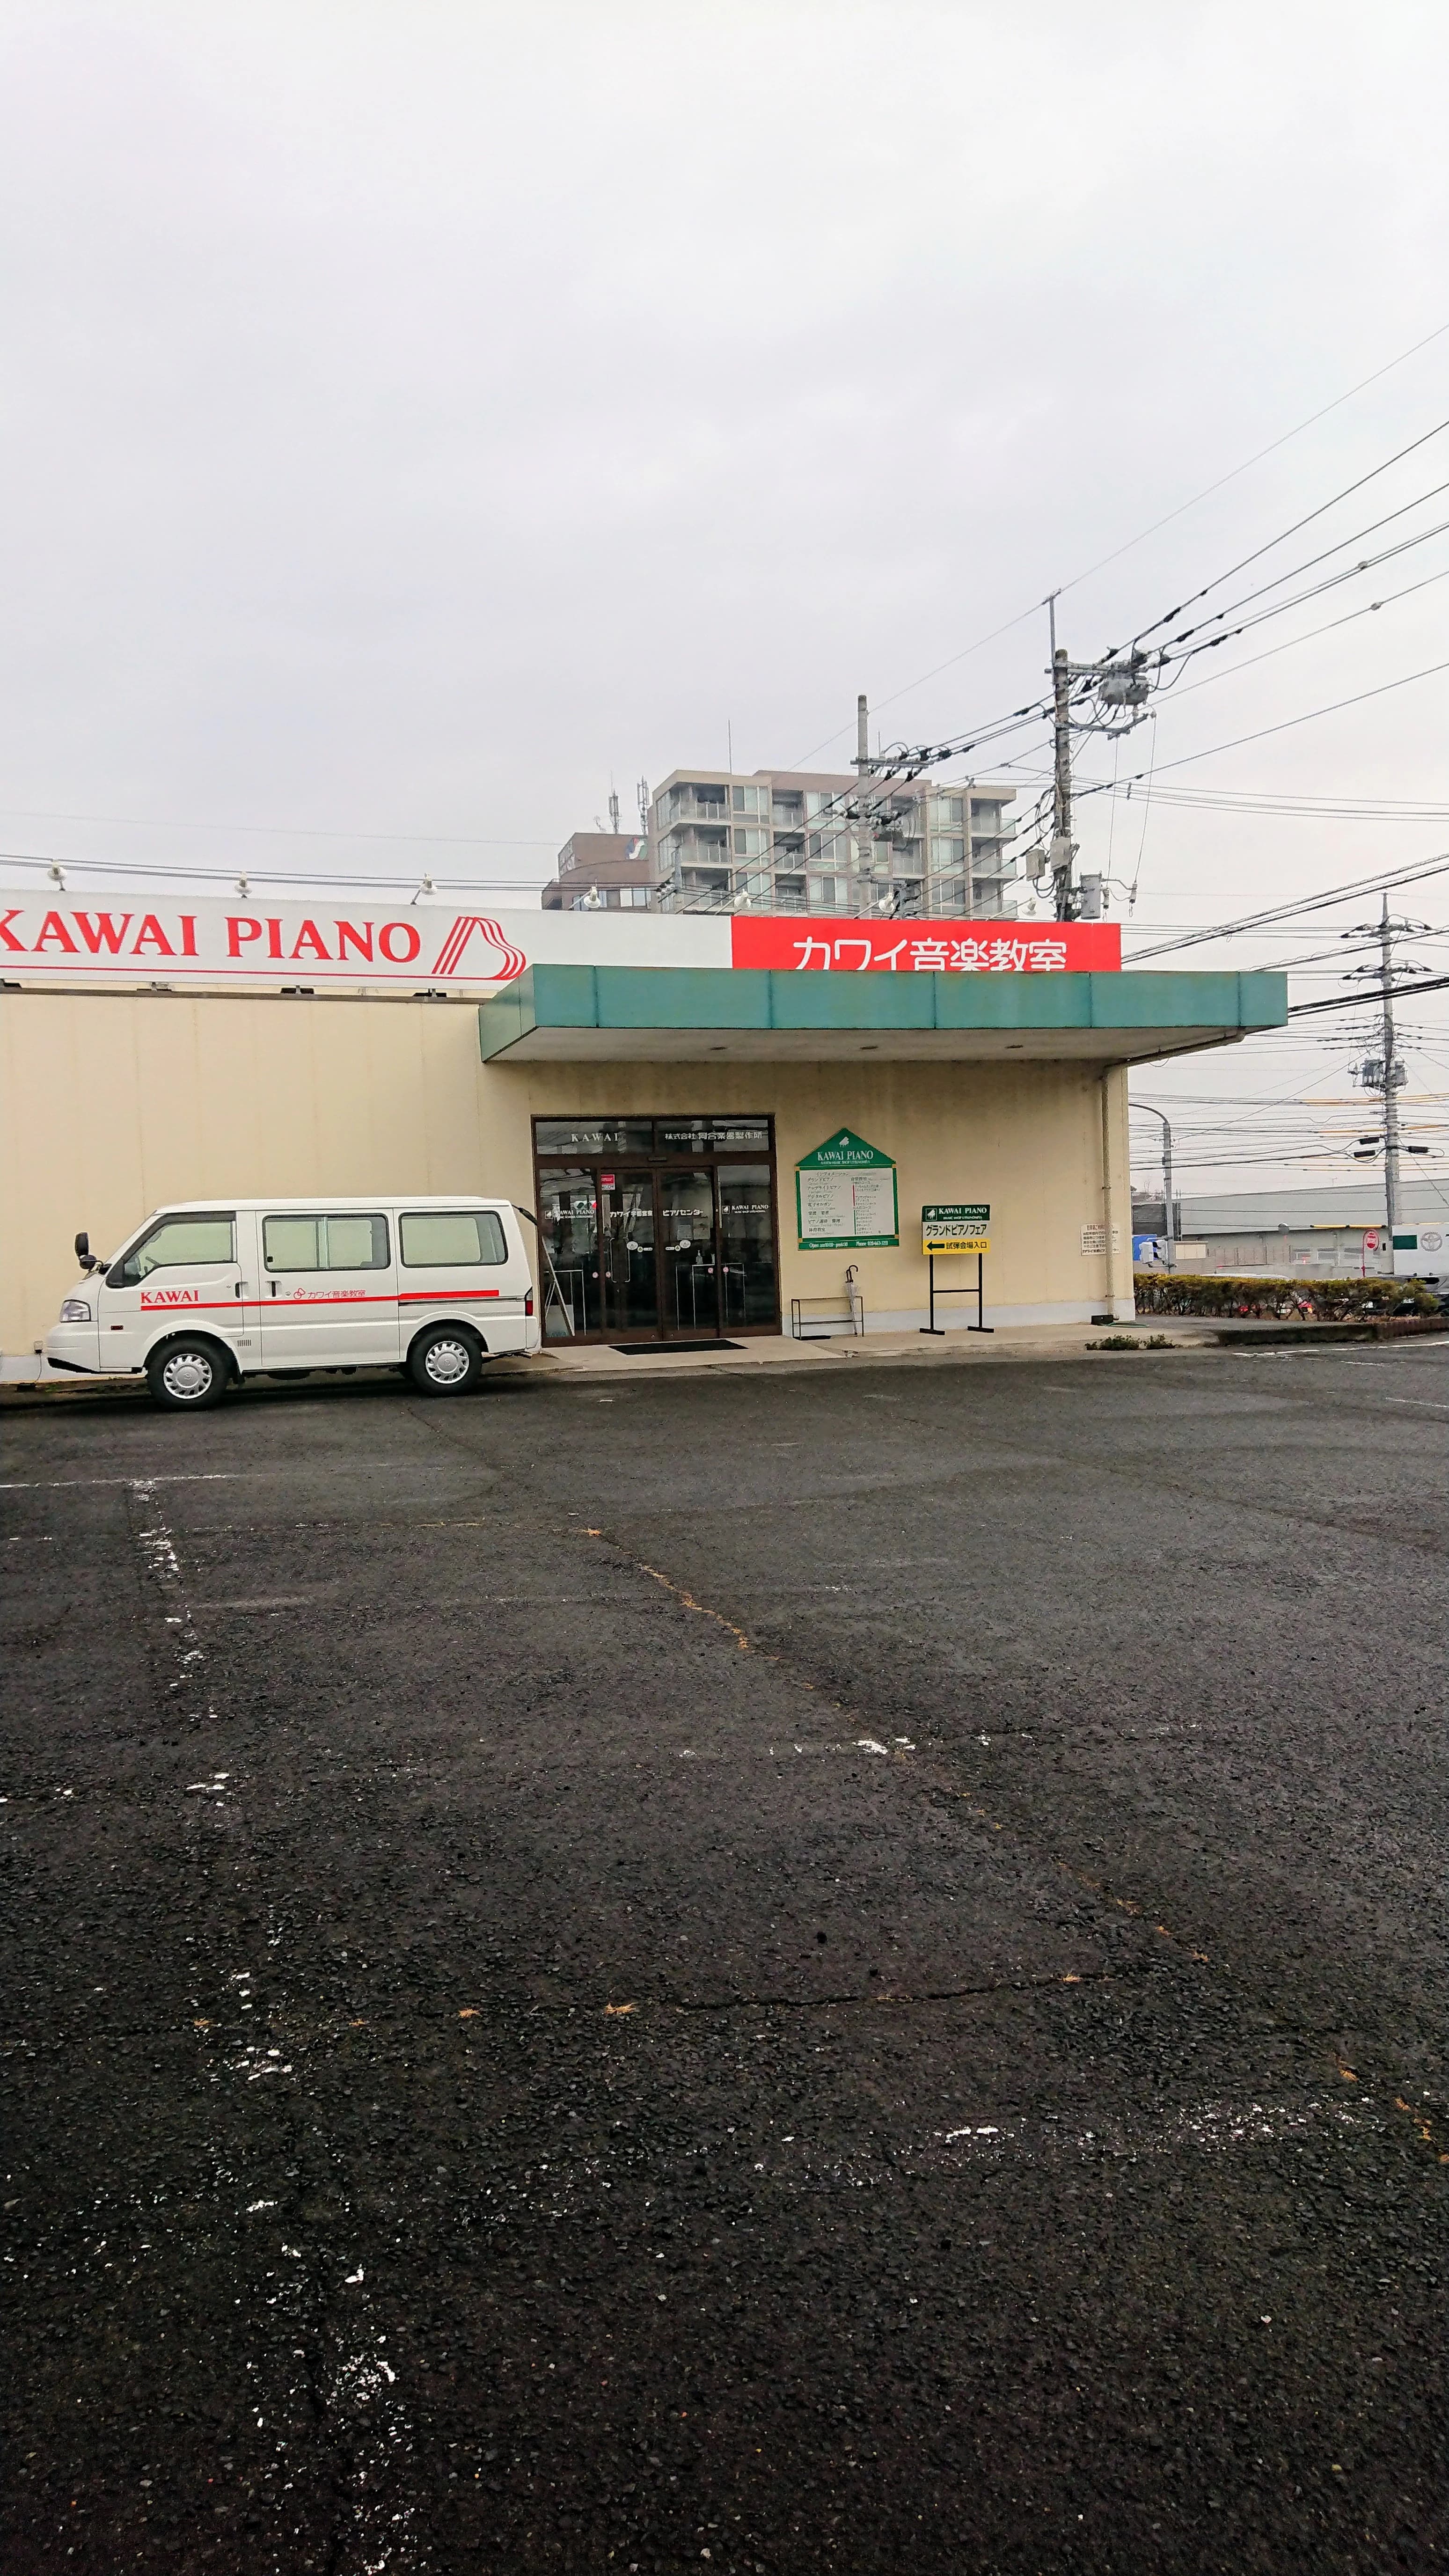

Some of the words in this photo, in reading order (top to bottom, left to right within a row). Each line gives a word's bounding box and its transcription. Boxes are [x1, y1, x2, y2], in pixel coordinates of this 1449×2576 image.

[0, 909, 200, 956] KAWAI
[224, 916, 421, 963] PIANO
[793, 937, 1067, 971] カワイ音楽教室
[571, 1133, 619, 1142] KAWAI
[817, 1151, 844, 1161] KAWAI
[847, 1150, 874, 1160] PIANO
[926, 1224, 987, 1236] グランドピアノフェア
[946, 1241, 987, 1250] 試弾会場入口
[140, 1290, 199, 1303] KAWAI
[307, 1290, 366, 1299] カワイ音楽教室
